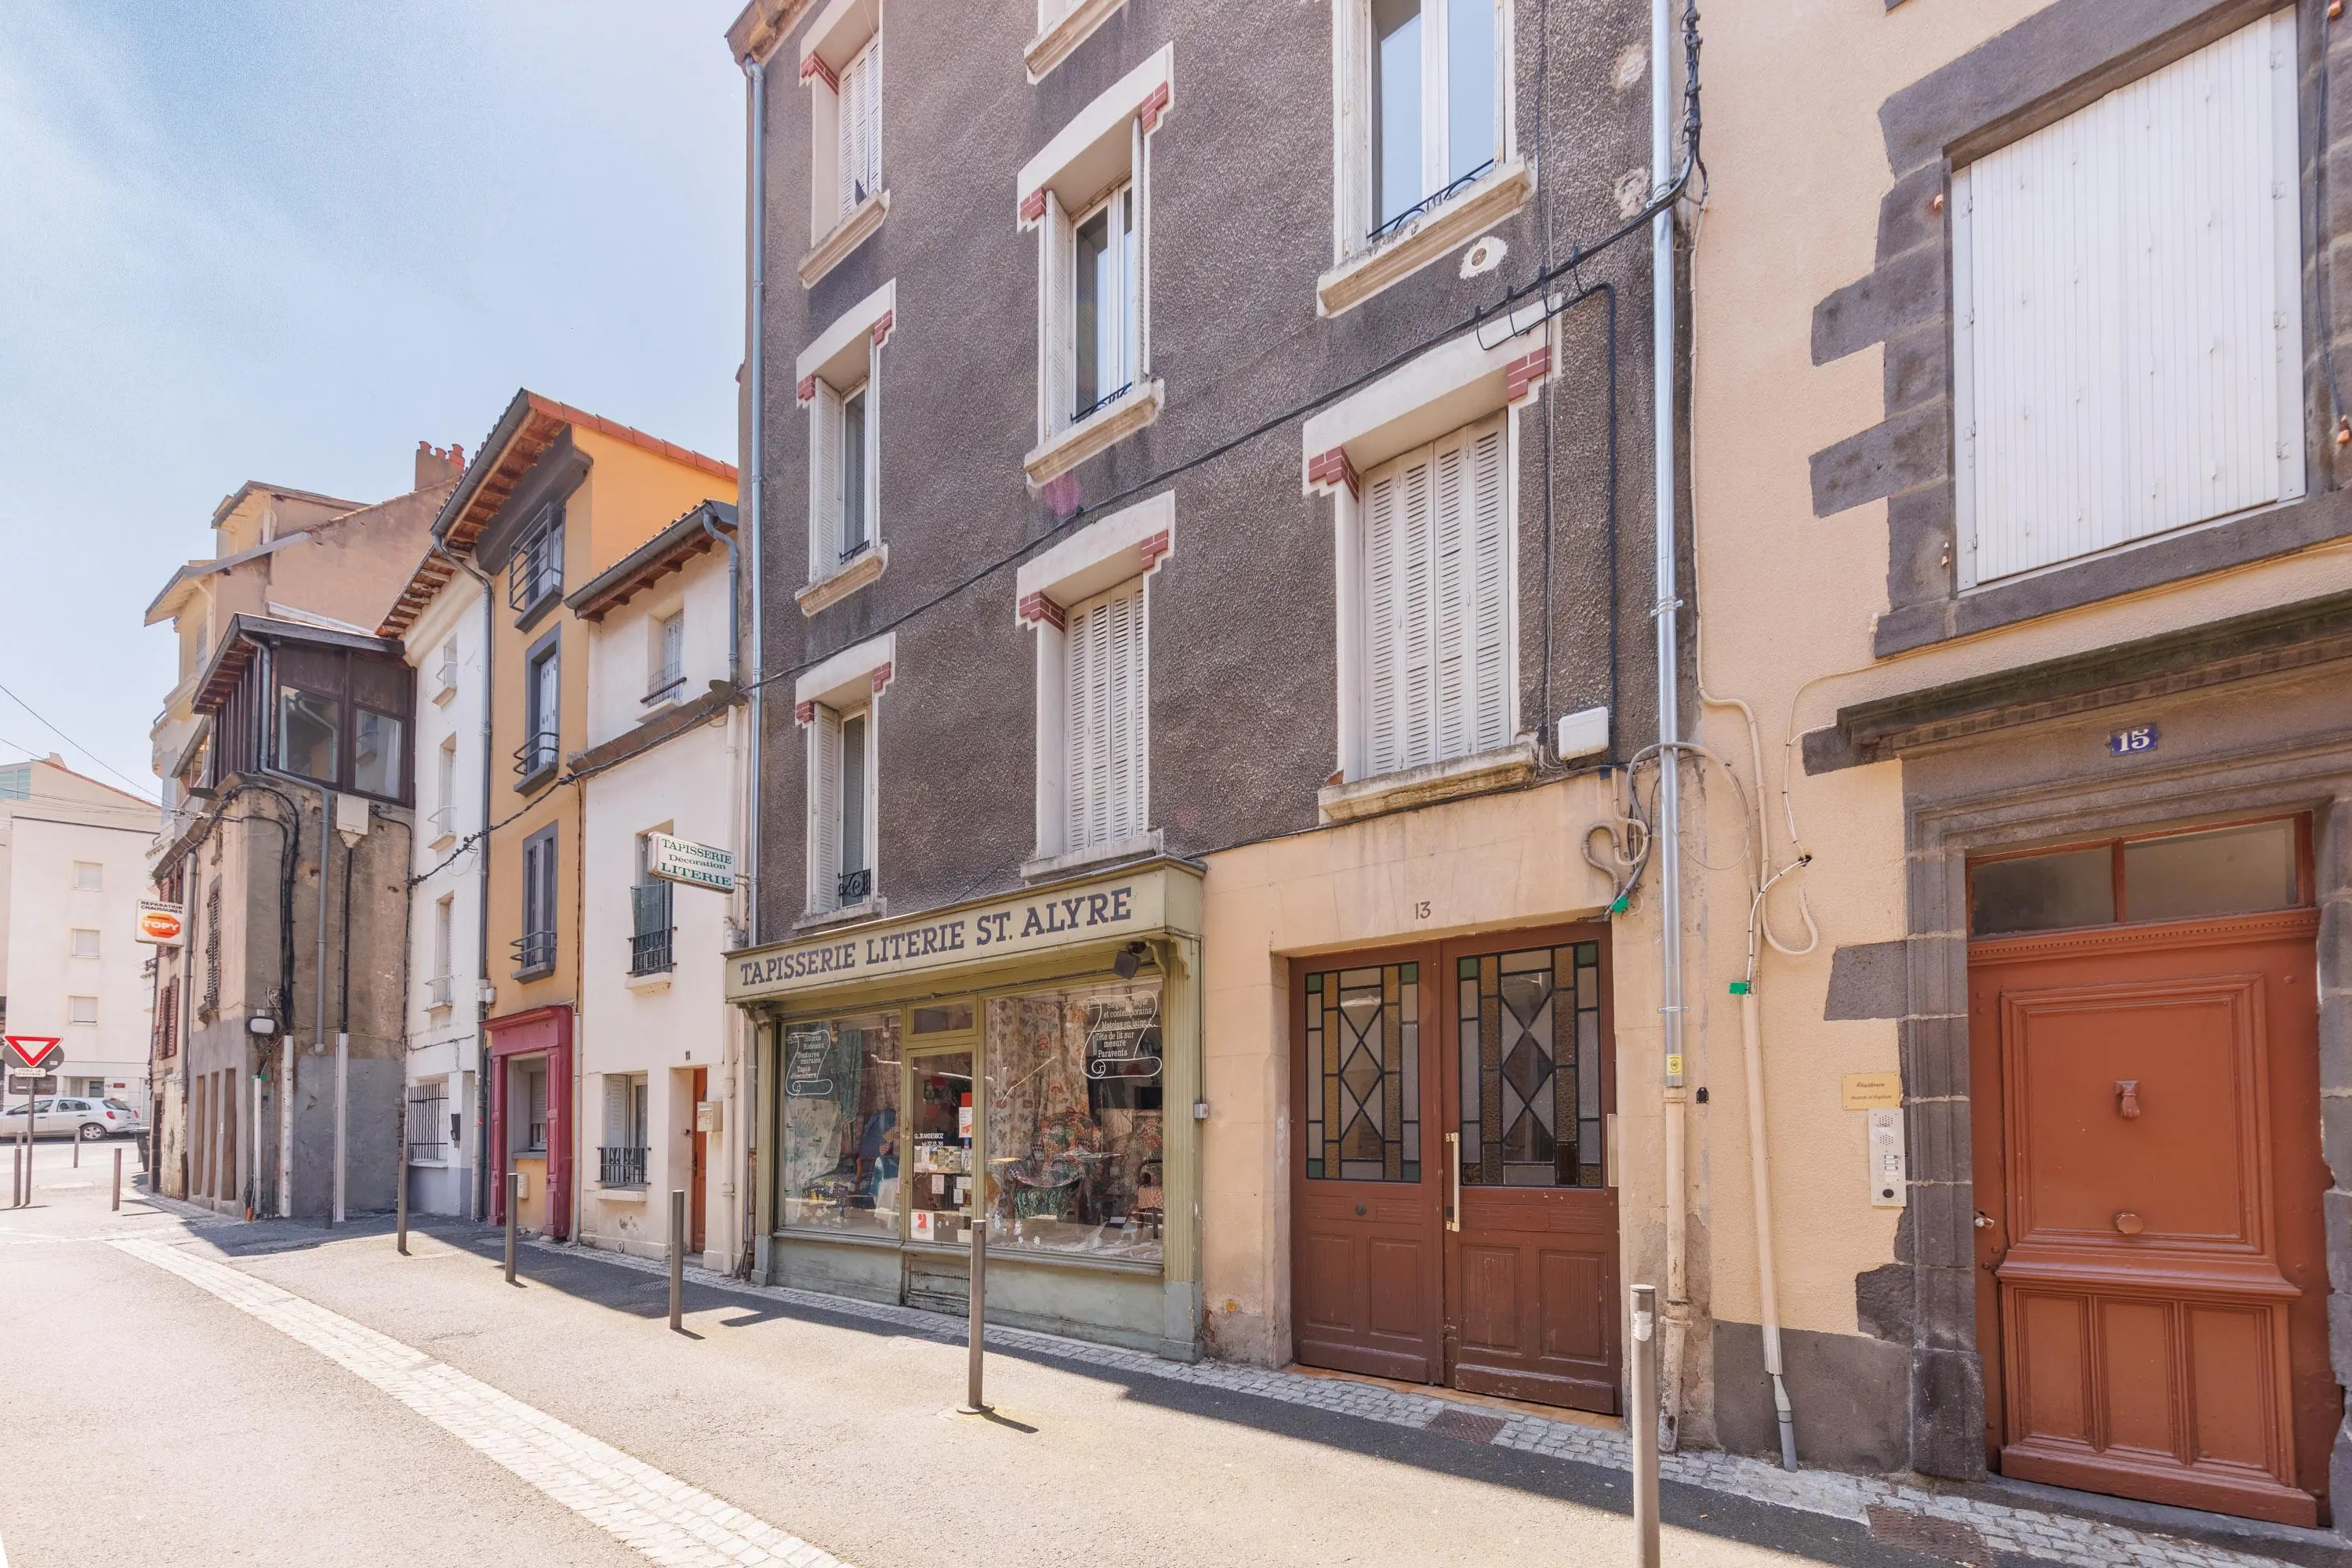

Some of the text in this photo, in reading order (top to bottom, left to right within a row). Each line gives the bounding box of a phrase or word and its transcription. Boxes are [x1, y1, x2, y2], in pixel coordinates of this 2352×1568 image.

[2119, 728, 2150, 752] 15
[661, 838, 732, 865] TAPISSERIE
[669, 854, 727, 870] Décoration
[661, 862, 731, 886] LITERIE
[1415, 901, 1432, 920] 13
[143, 920, 180, 931] TOPY
[740, 887, 1132, 986] TAPISSERIE LITERIE ST. ALYRE
[1134, 997, 1149, 1007] style
[1109, 1007, 1152, 1018] contemporains
[1102, 1020, 1123, 1030] Matelas
[1103, 1040, 1127, 1048] mesure
[684, 1050, 691, 1061] 11
[1098, 1050, 1128, 1058] Paravents
[797, 1065, 811, 1074] Tapis
